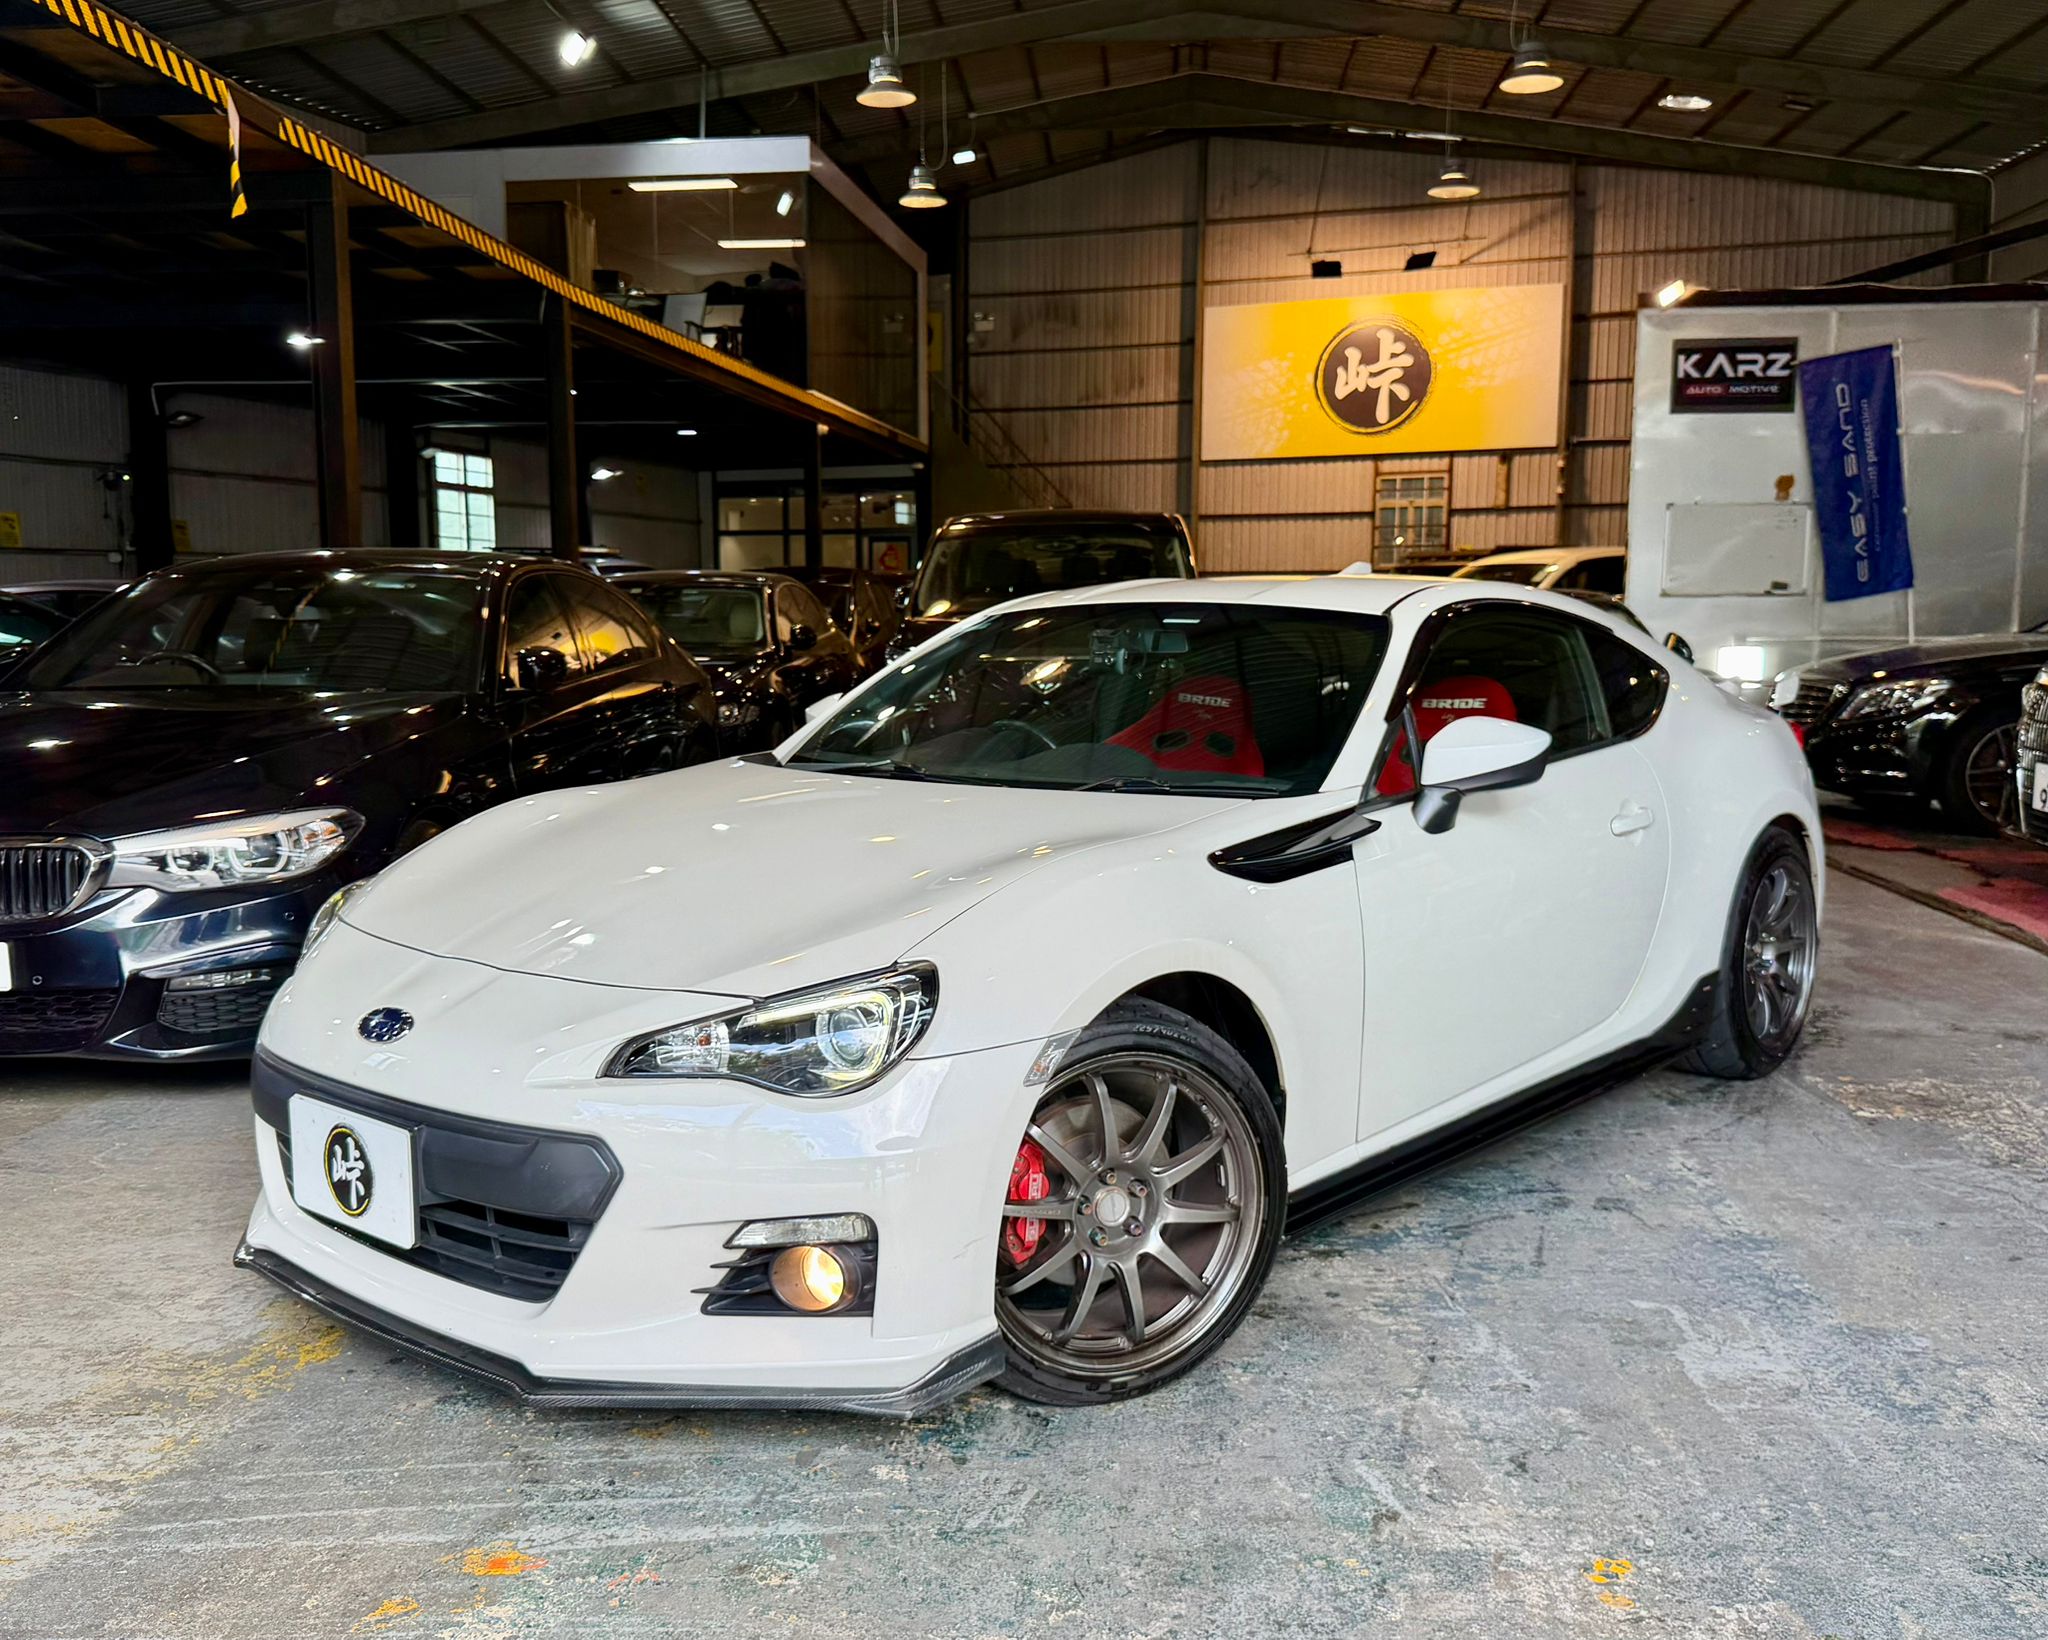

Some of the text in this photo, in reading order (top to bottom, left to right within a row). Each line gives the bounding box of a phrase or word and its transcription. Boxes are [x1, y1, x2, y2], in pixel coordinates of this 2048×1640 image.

[1334, 328, 1415, 424] 峠
[1677, 352, 1793, 379] KARZ
[1685, 384, 1780, 395] AUTO MOTIVE
[1835, 382, 1869, 582] EASY SAND
[1177, 692, 1233, 708] BRIDE
[1421, 698, 1488, 709] BRIDE
[333, 1136, 365, 1210] 峠
